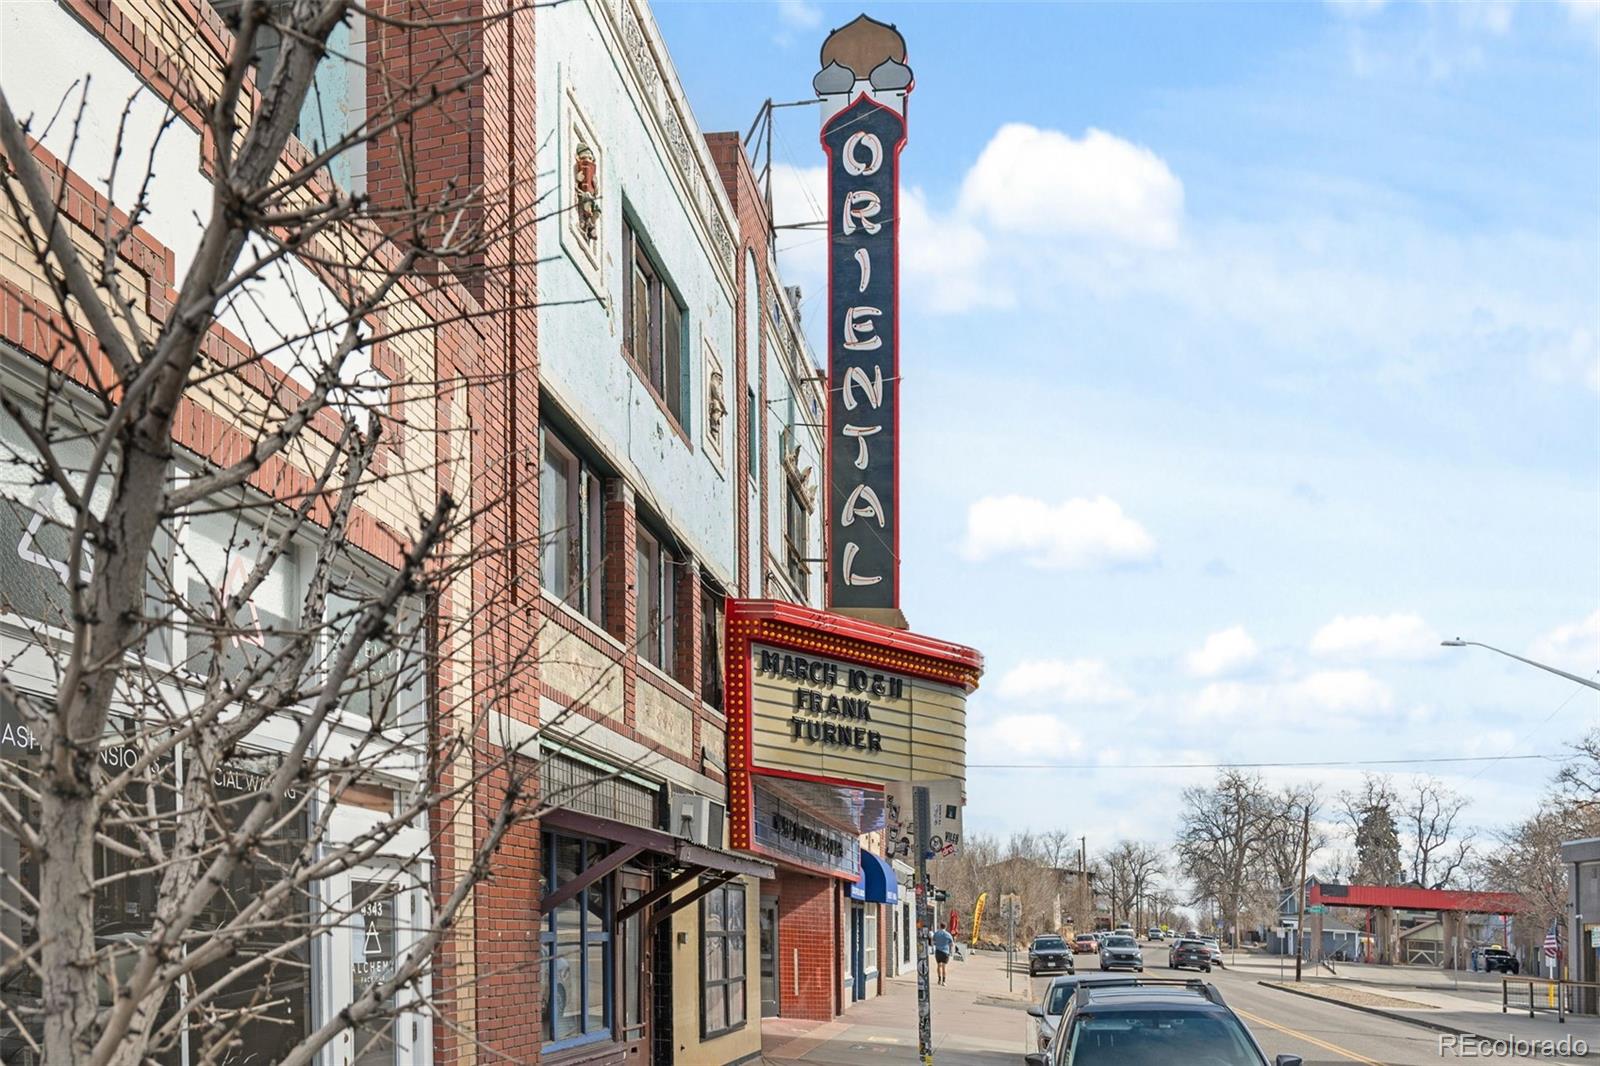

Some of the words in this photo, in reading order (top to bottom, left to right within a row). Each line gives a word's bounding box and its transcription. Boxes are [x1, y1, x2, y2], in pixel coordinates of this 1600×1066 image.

[841, 130, 886, 586] ORIENTAL
[761, 650, 838, 686] MARCH
[797, 687, 872, 722] FRANK
[791, 715, 883, 752] TURNER
